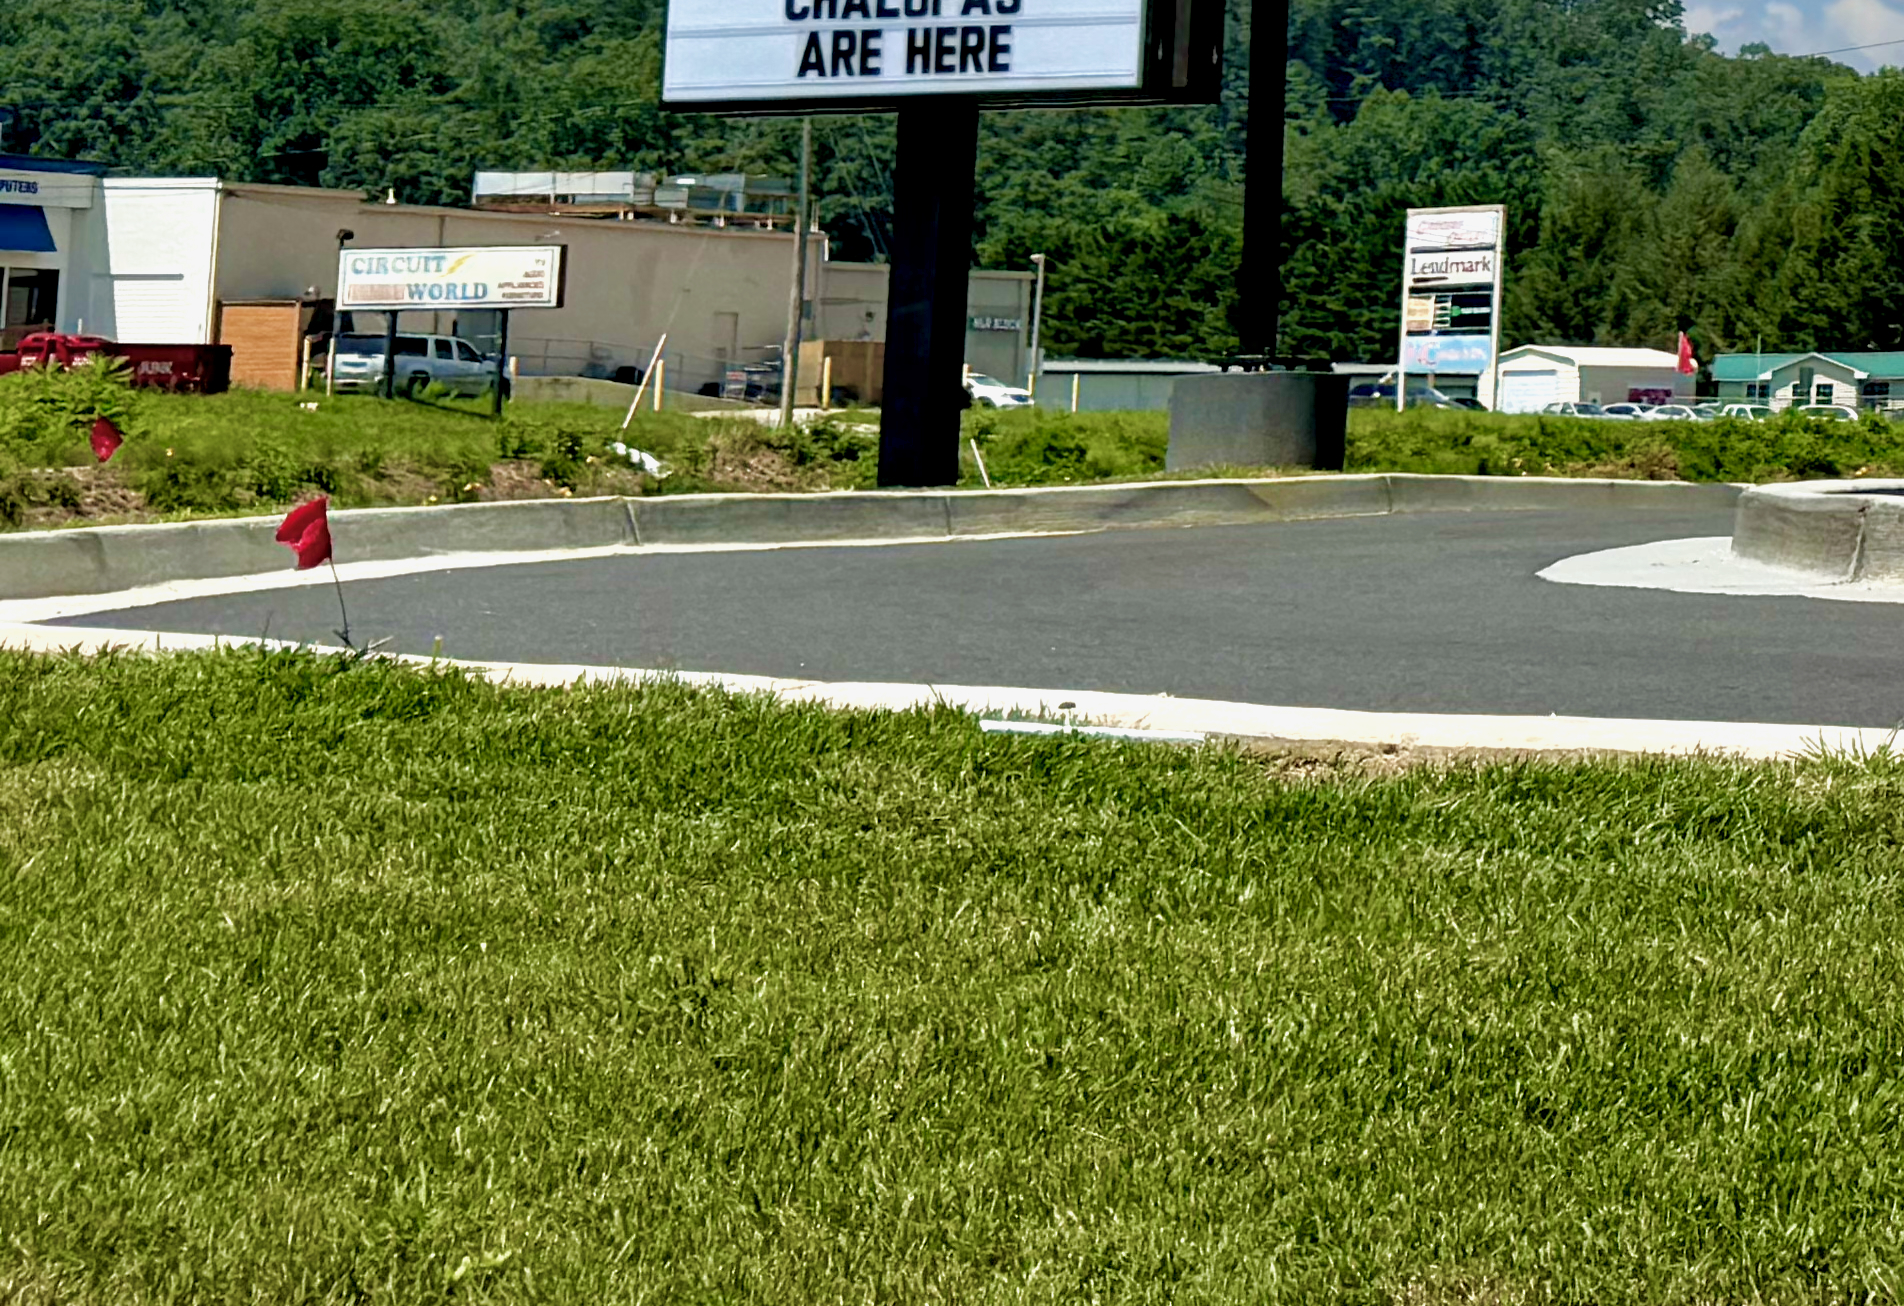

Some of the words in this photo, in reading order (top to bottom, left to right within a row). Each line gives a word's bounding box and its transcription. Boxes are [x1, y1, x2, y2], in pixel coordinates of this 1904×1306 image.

[797, 29, 882, 78] ARE
[905, 24, 1013, 75] HERE
[351, 255, 447, 276] CIRCUIT
[1410, 255, 1491, 275] Lendmark
[405, 282, 488, 301] WORLD
